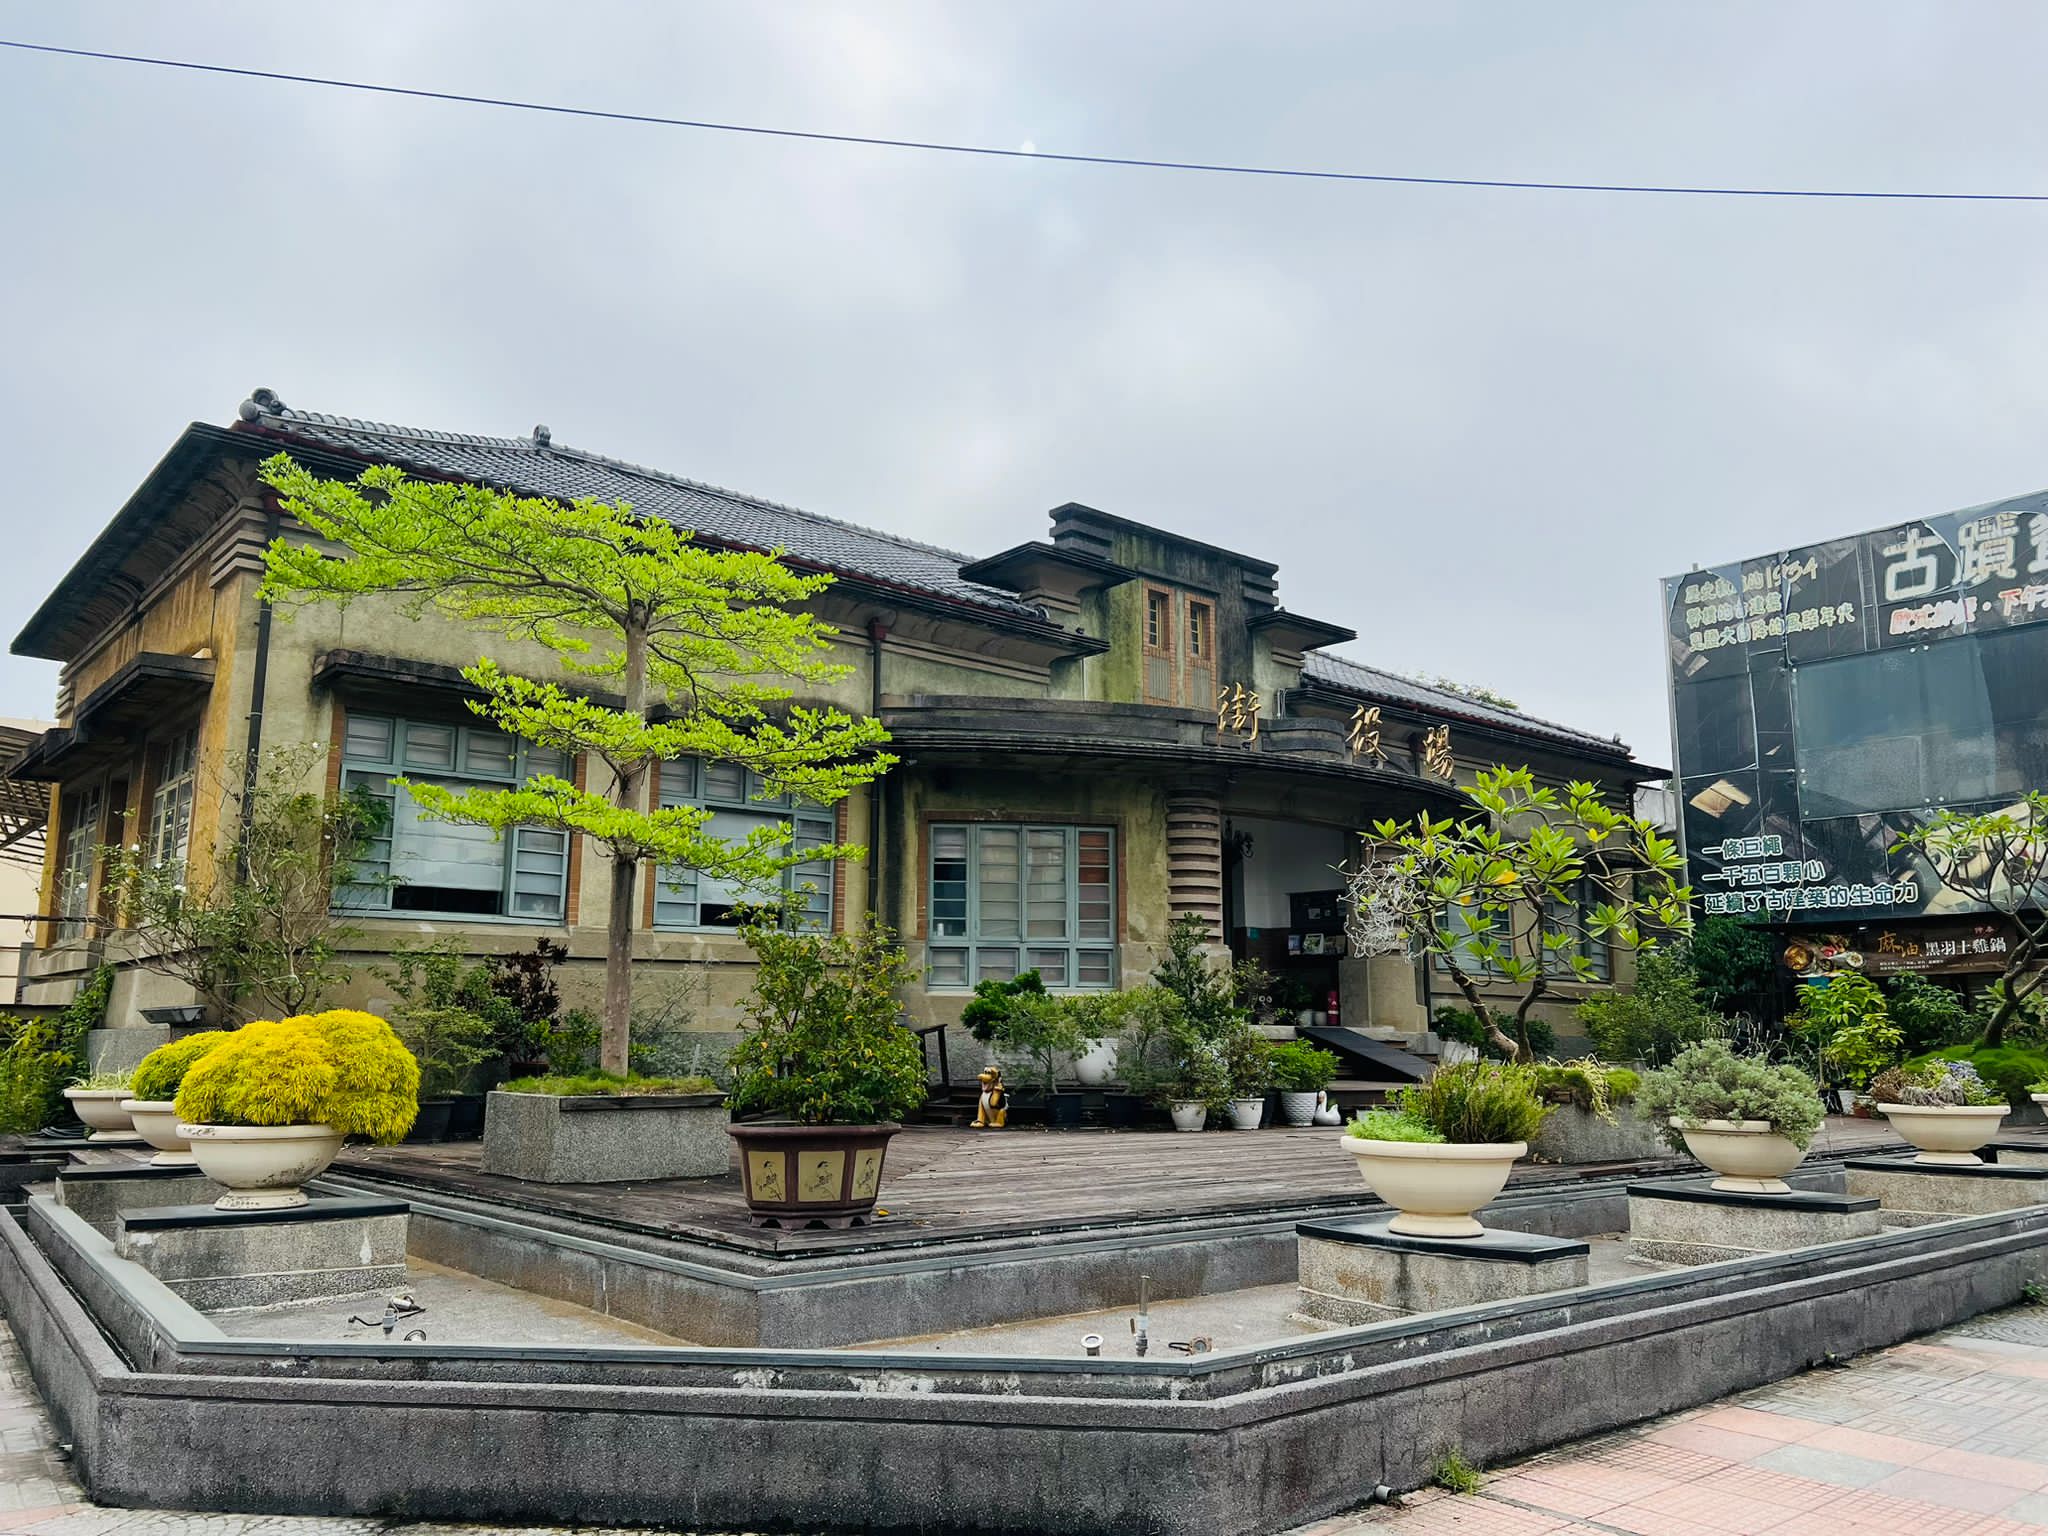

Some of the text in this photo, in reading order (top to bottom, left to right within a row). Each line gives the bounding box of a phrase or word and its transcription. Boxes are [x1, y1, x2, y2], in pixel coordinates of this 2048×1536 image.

[1702, 835, 1783, 860] 一條巨繩
[1702, 860, 1825, 887] 一千五百顆心
[1705, 882, 1919, 915] 延續了古建築的生命力
